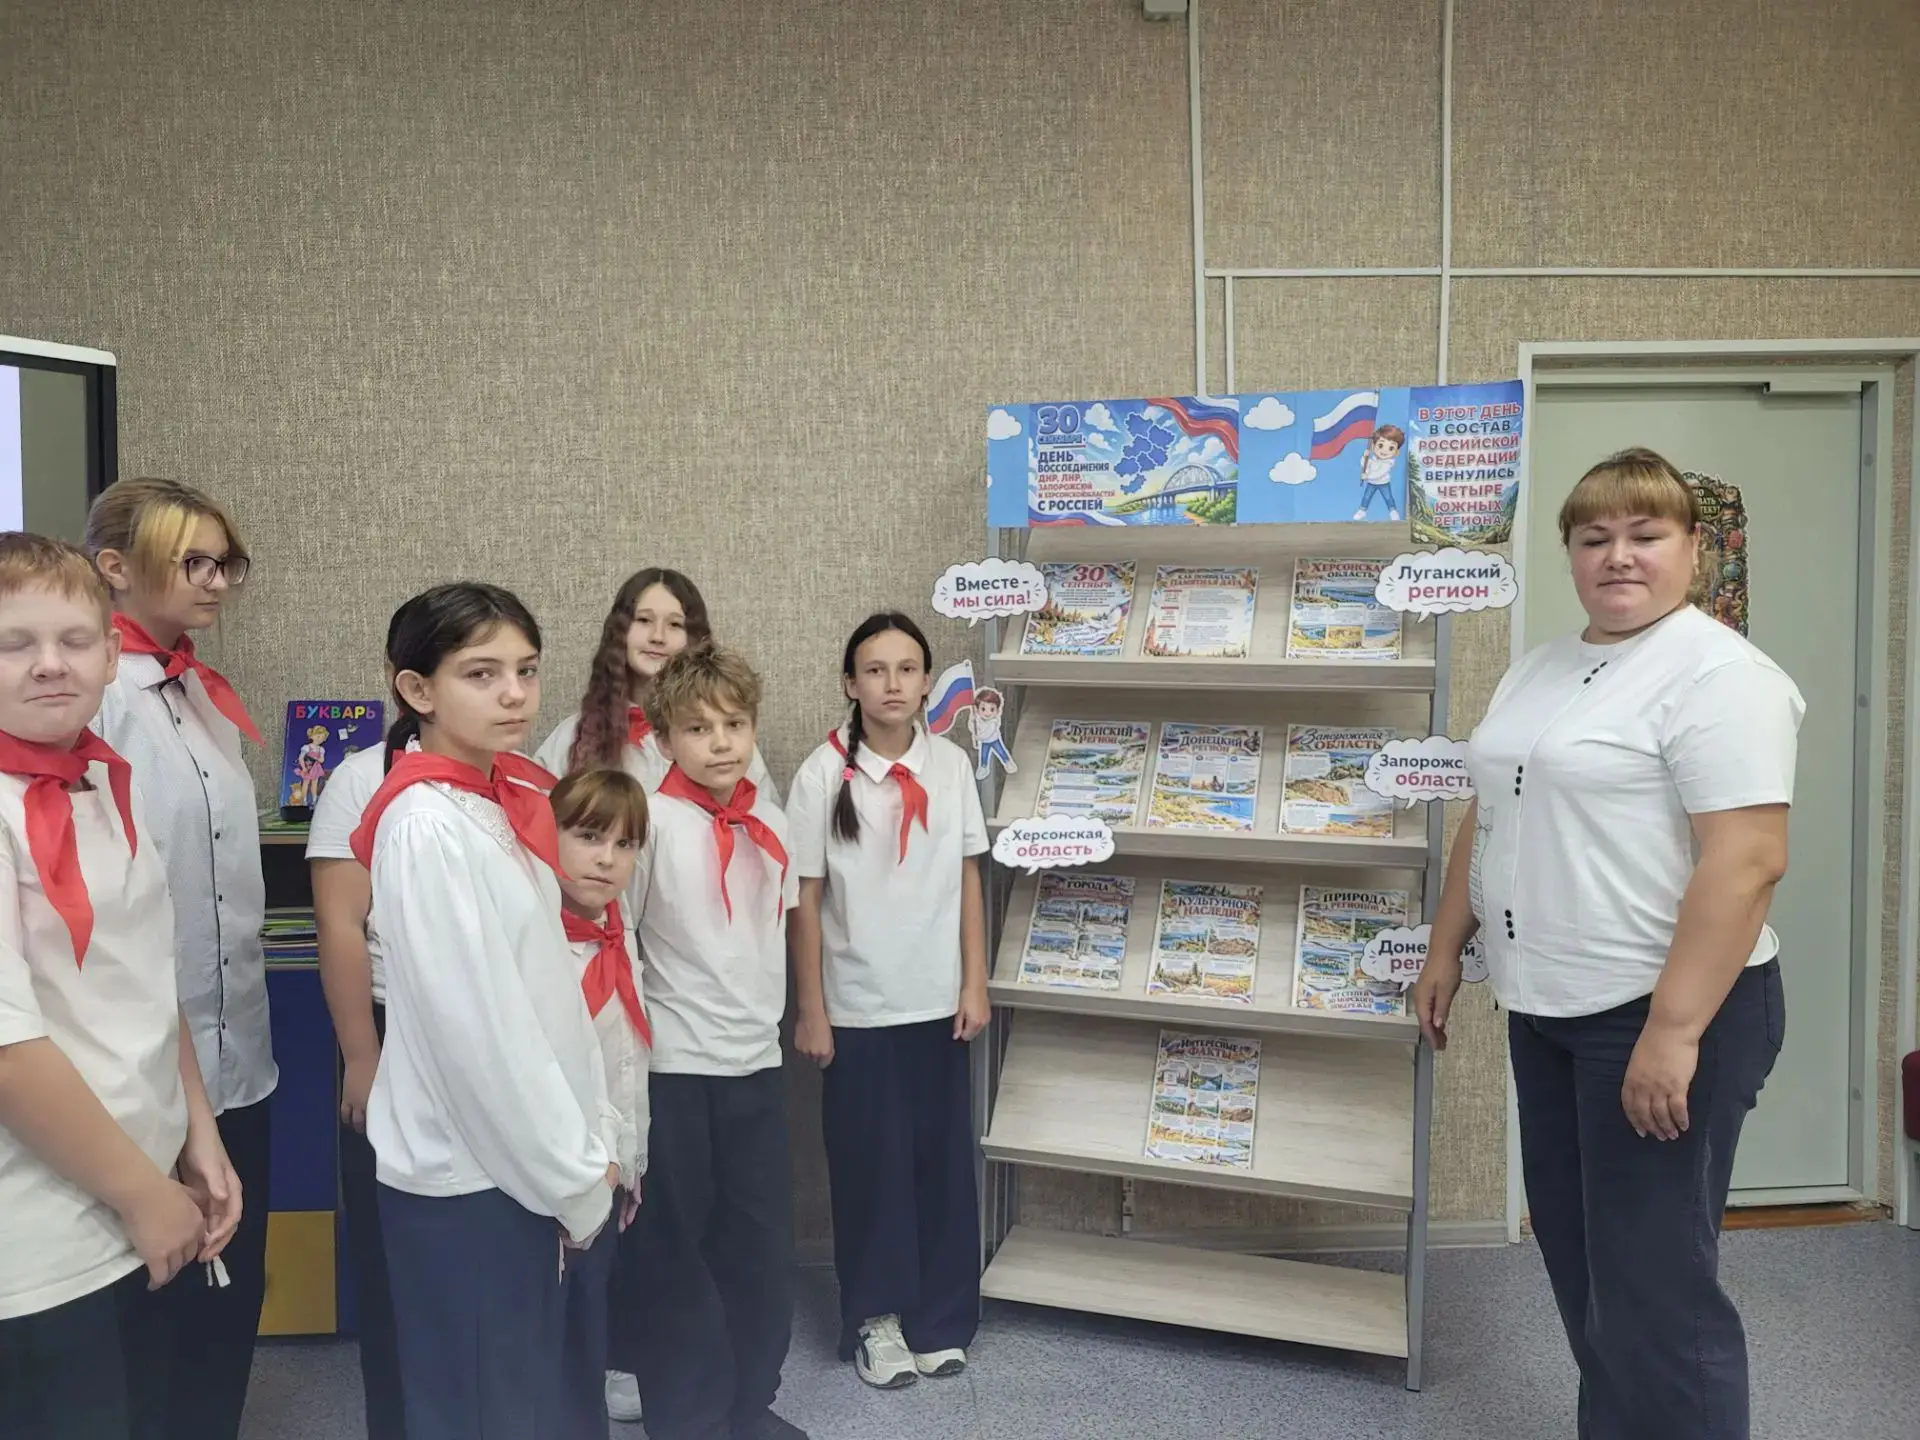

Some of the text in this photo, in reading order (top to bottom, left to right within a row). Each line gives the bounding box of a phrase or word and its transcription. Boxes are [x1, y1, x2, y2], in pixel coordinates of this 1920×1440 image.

[1419, 402, 1521, 420] В ЭТОТ ДЕНЬ
[1038, 405, 1080, 434] 30
[1430, 420, 1511, 435] В СОСТАВ
[1419, 434, 1519, 451] РОССИЙСКОЙ
[1038, 451, 1074, 464] ДЕНЬ
[1422, 451, 1518, 467] ФЕДЕРАЦИИ
[1425, 468, 1515, 481] ВЕРНУЛИСЬ
[1437, 484, 1503, 498] ЧЕТЫРЕ
[1037, 500, 1046, 511] С
[1435, 500, 1502, 513] ЮЖНЫХ
[1434, 514, 1502, 526] РЕГИОНА
[1072, 566, 1105, 581] 30
[1398, 563, 1501, 582] Луганский
[955, 576, 1019, 592] Вместе
[952, 590, 1032, 608] мы сила!
[1408, 585, 1489, 602] регион
[295, 705, 376, 720] БУКВАРЬ
[1315, 740, 1382, 750] ОБЛАСТЬ
[1379, 754, 1467, 774] Запорожс
[1012, 828, 1103, 843] Херсонская
[1016, 844, 1093, 857] область
[1178, 896, 1250, 909] КУЛЬТУРНОЕ
[1323, 892, 1387, 906] ПРИРОДА
[1390, 958, 1425, 973] рег
